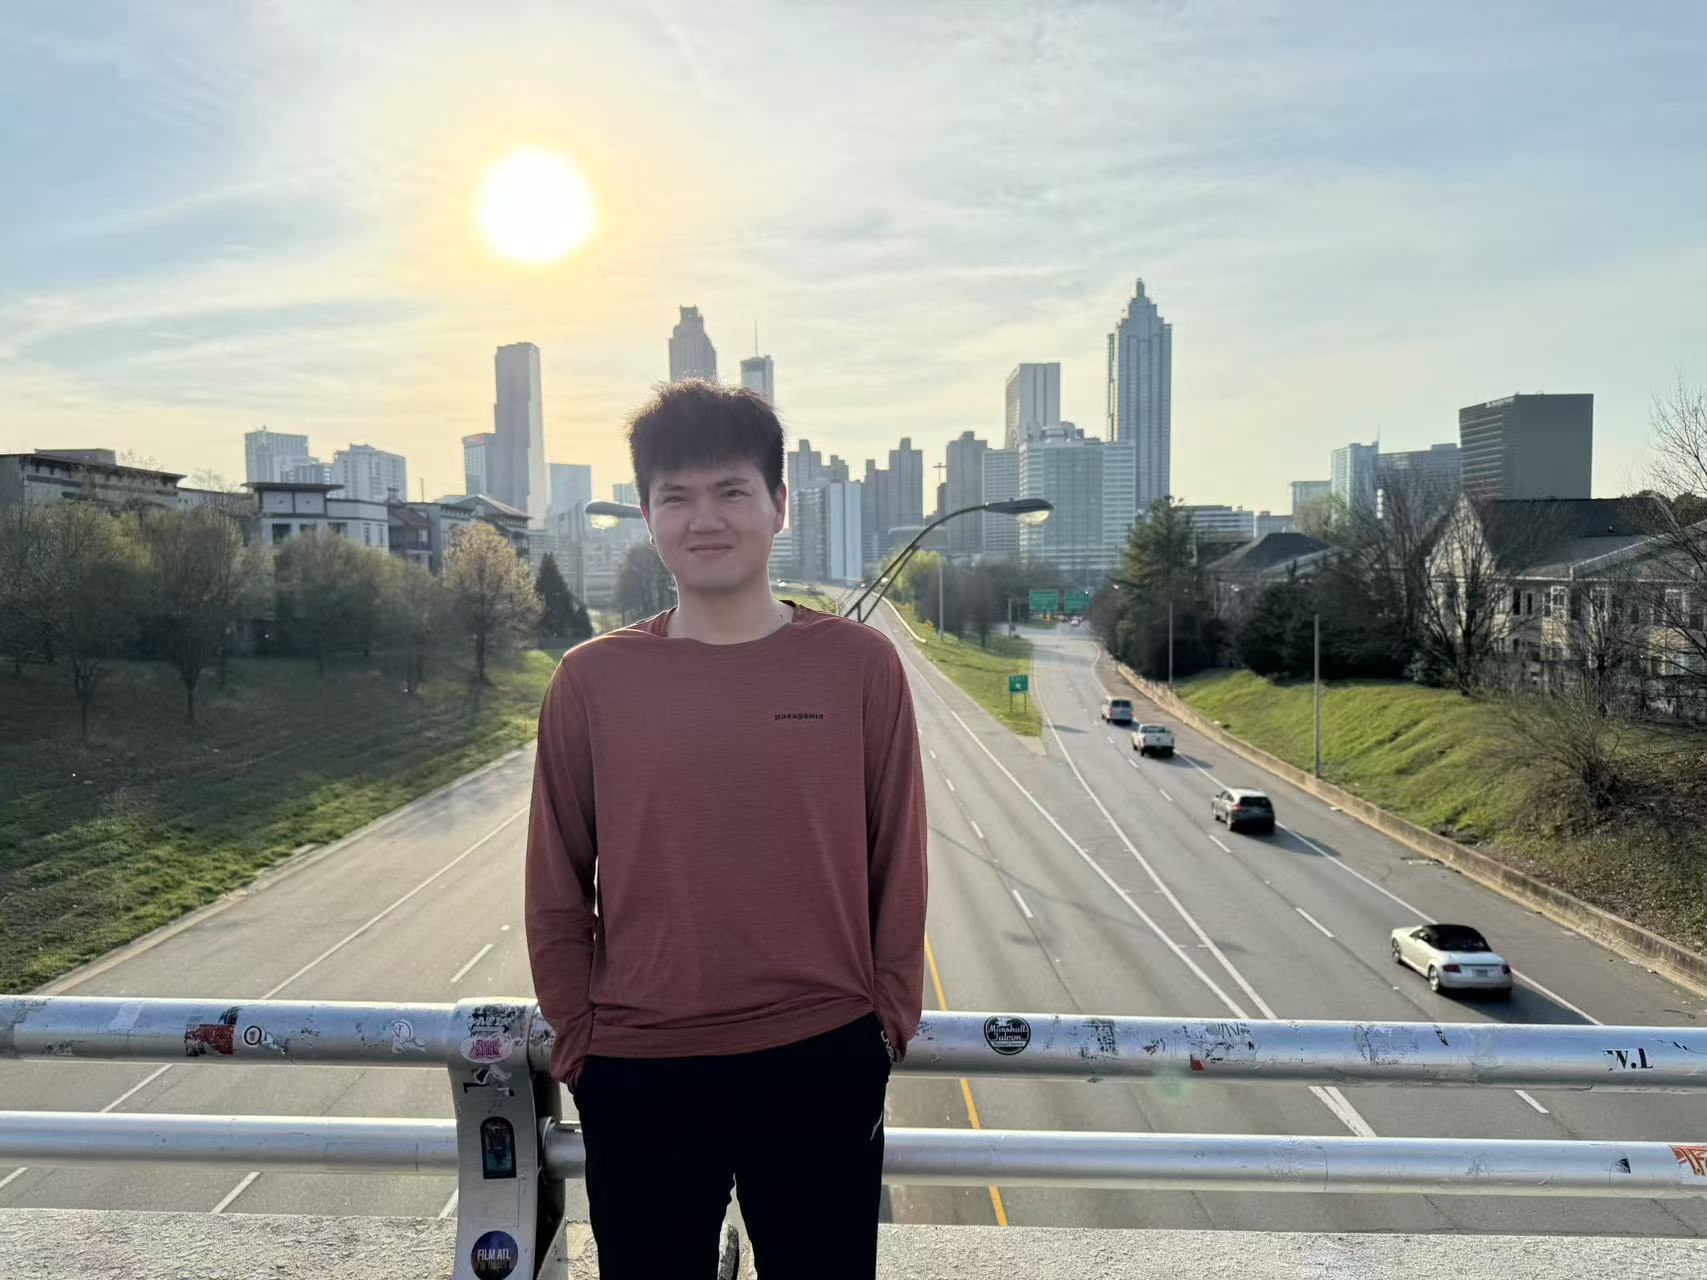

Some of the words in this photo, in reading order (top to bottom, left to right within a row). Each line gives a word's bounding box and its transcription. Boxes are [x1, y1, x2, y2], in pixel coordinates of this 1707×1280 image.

[774, 712, 824, 721] patagonia
[477, 1248, 496, 1261] FILM
[497, 1248, 511, 1260] ATL
